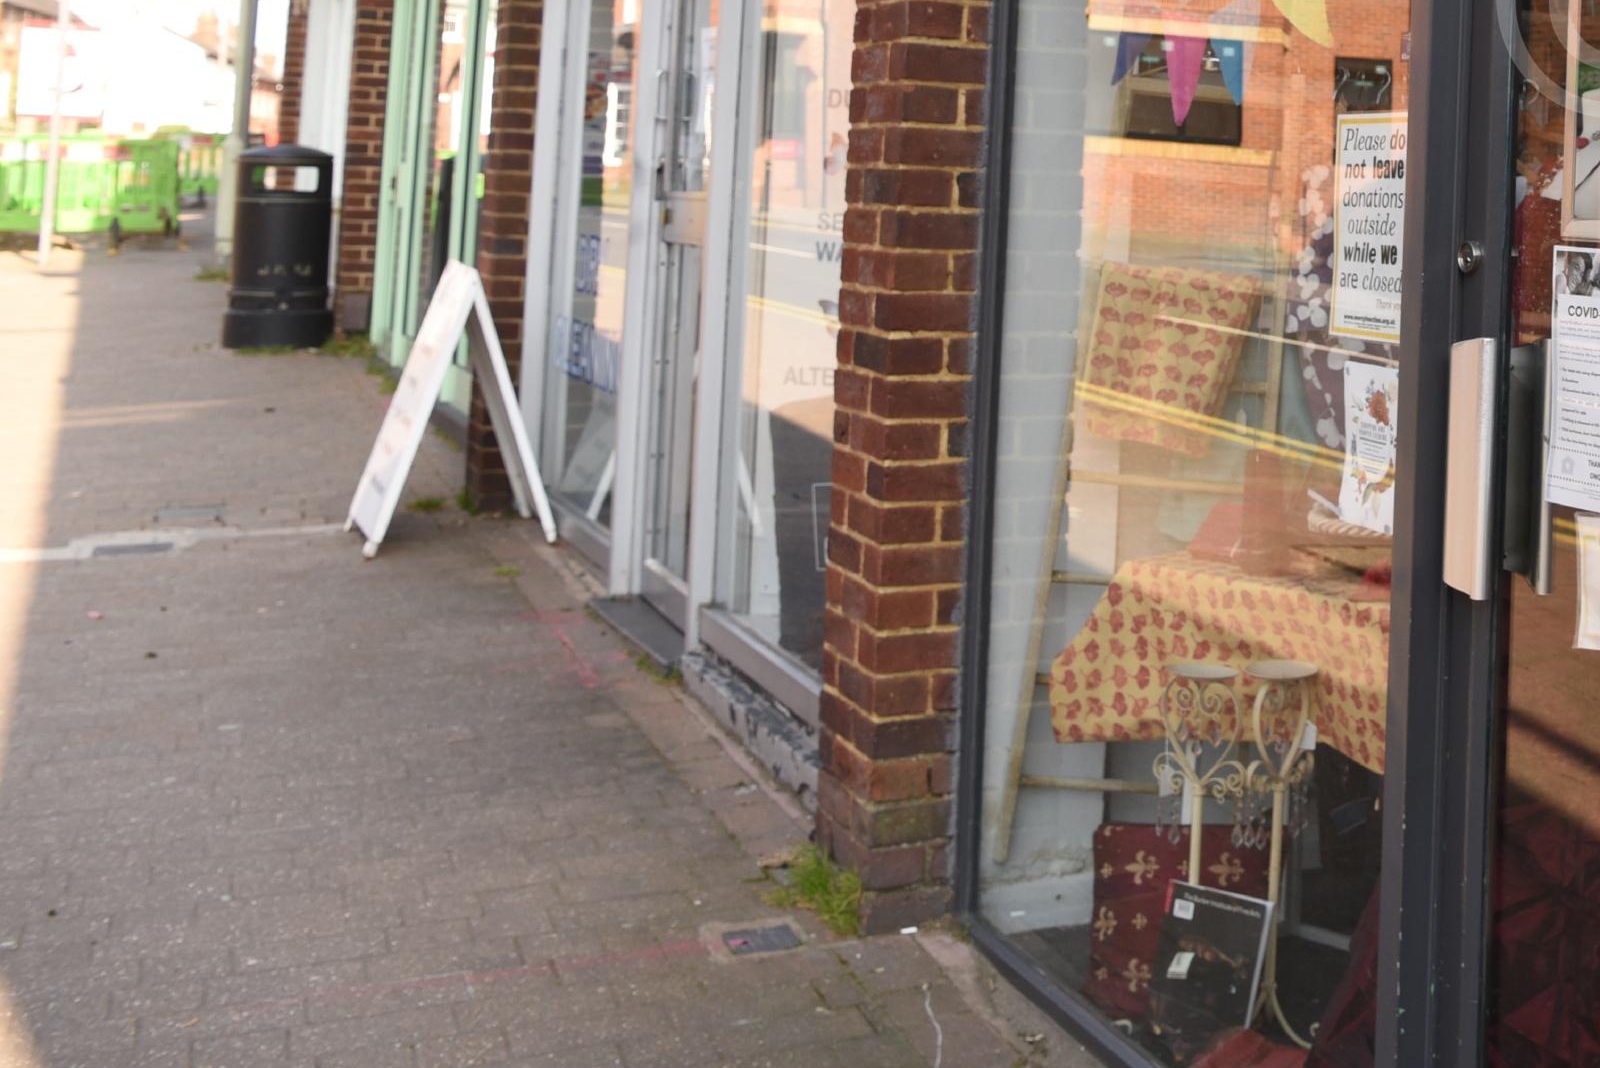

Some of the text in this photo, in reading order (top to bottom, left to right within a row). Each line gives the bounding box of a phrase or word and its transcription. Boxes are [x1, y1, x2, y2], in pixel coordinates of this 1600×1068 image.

[1344, 128, 1406, 151] Please do
[1345, 156, 1405, 179] not leave
[1343, 187, 1404, 208] donations
[1348, 213, 1396, 236] outside
[1344, 242, 1397, 265] while we
[1340, 271, 1358, 289] are
